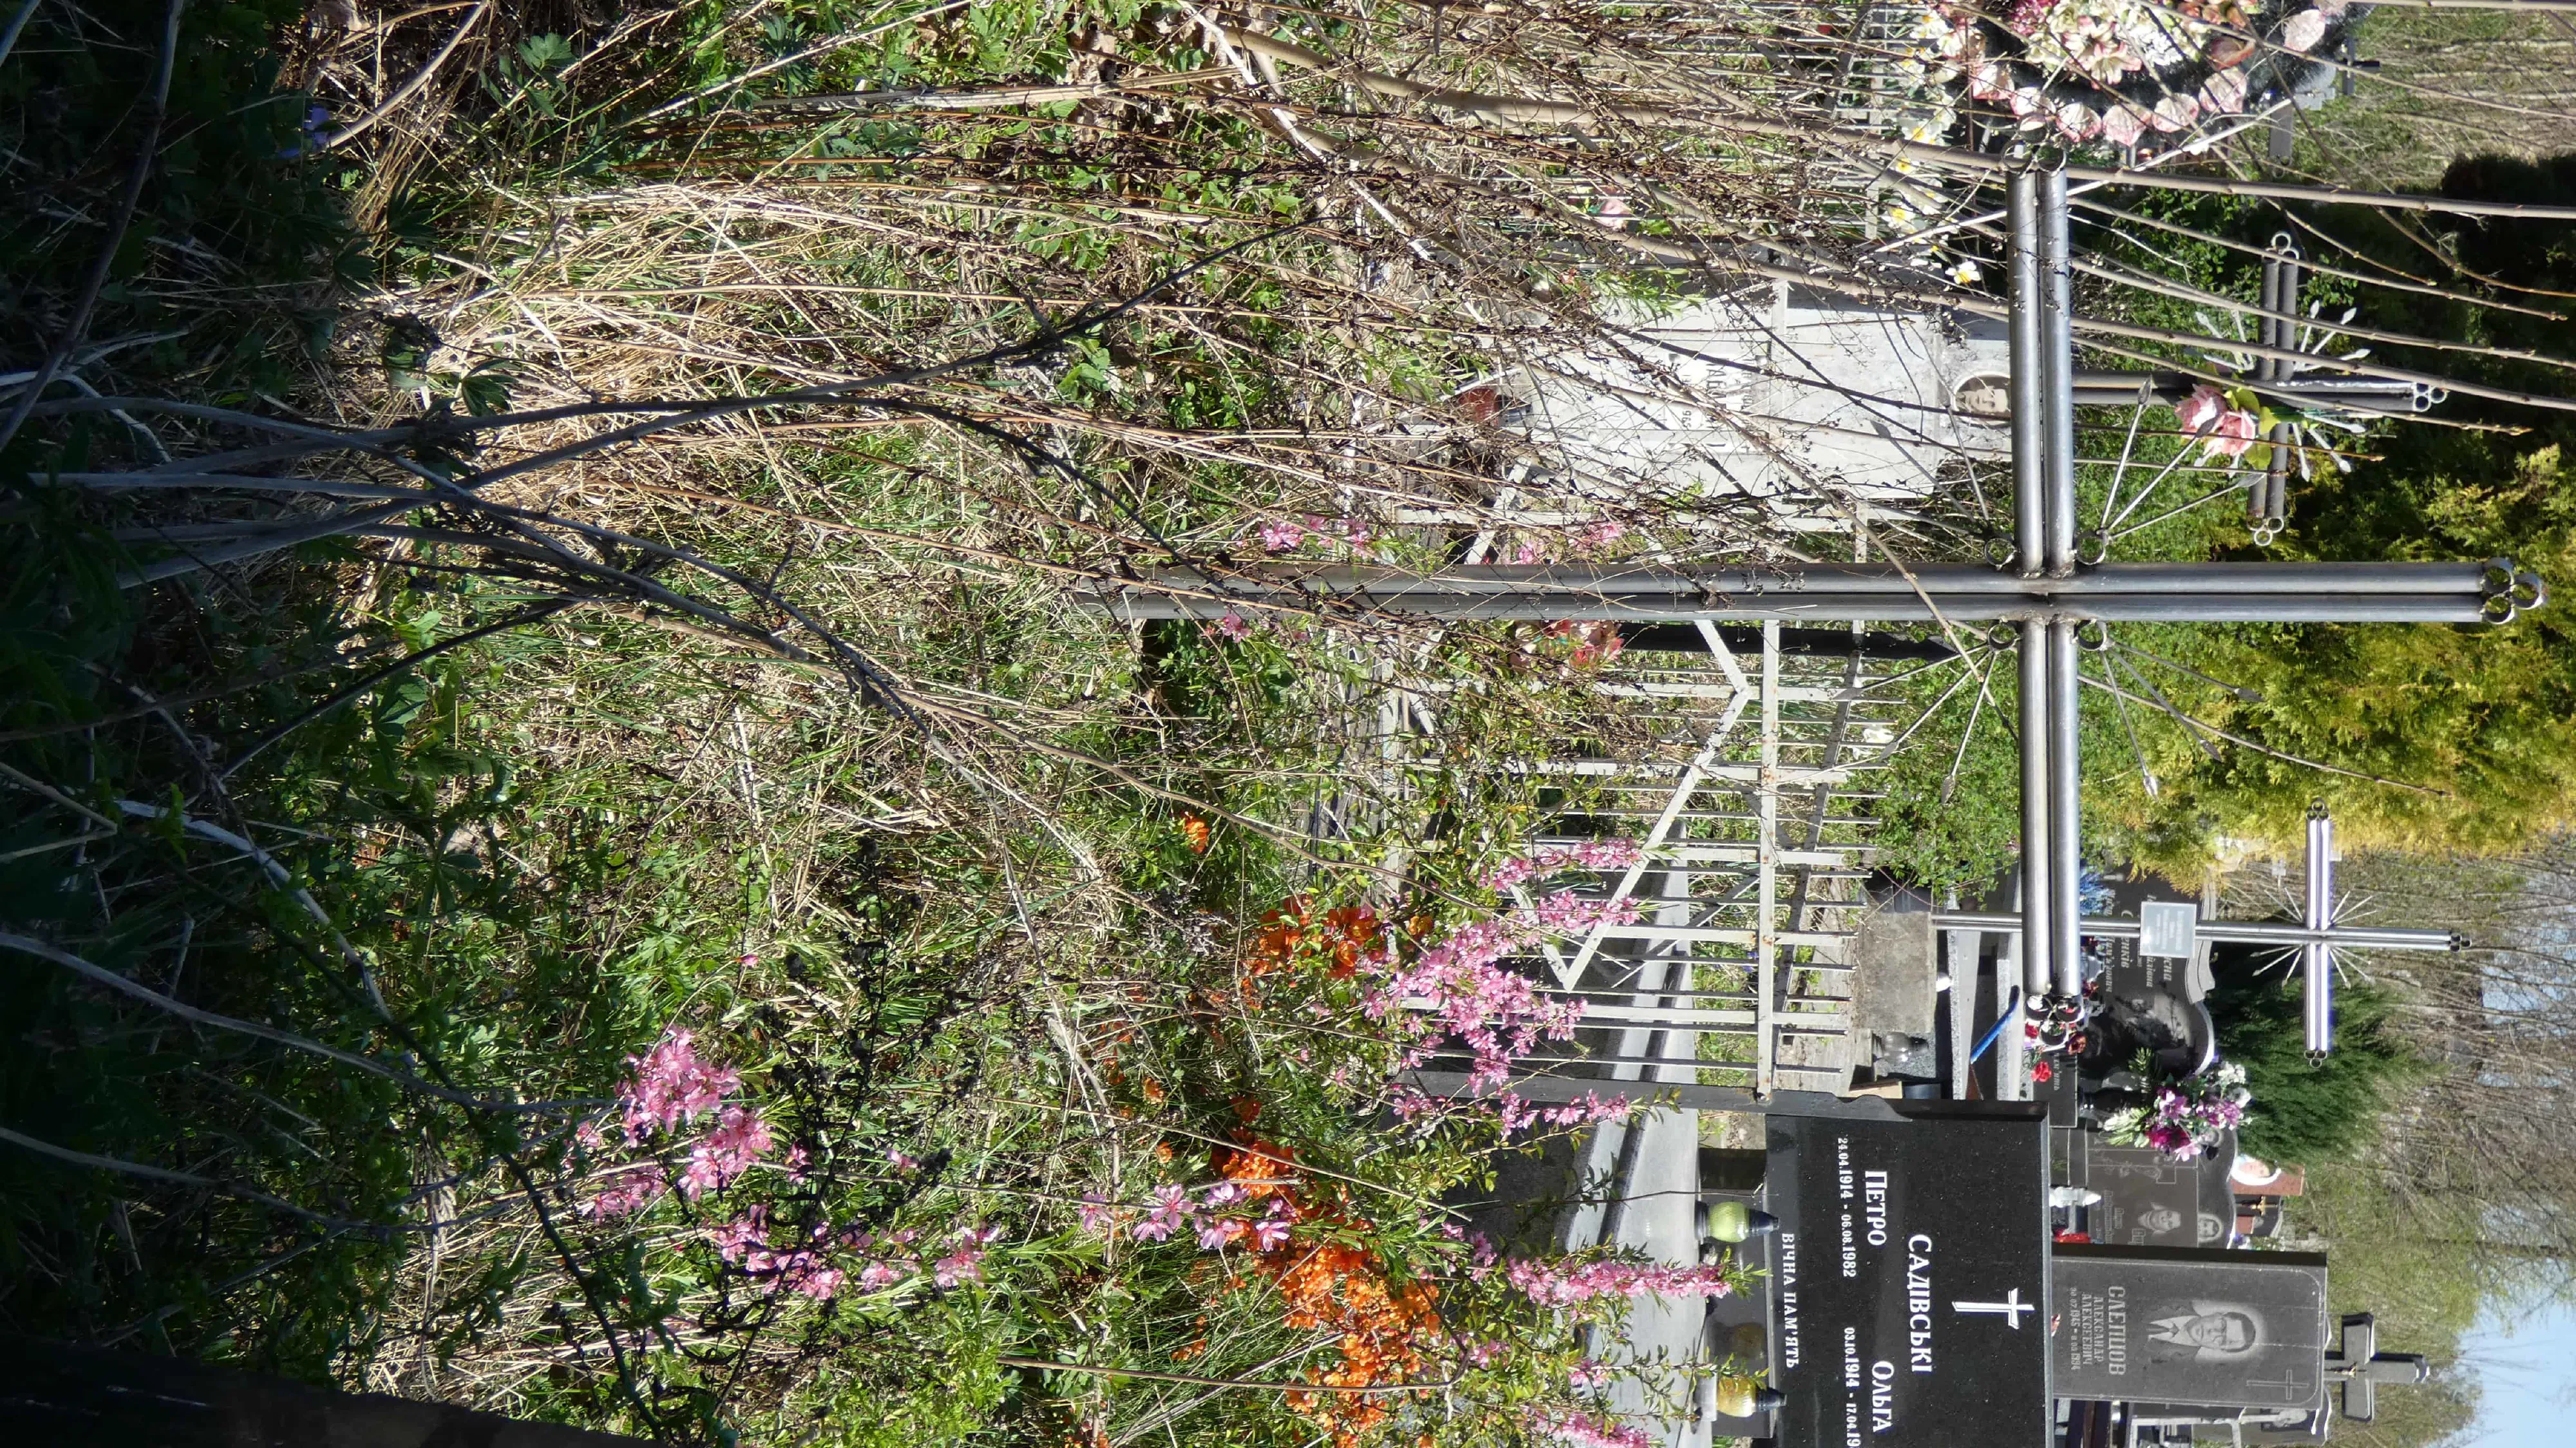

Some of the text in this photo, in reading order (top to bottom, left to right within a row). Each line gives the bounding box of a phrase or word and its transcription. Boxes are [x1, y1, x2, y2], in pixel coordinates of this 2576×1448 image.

[1837, 1138, 1854, 1199] 24.04.1914
[1781, 1233, 1796, 1286] ВІЧНА
[1841, 1214, 1857, 1277] 06.08.1982
[1843, 1327, 1860, 1387] 03.10.1914
[2093, 1297, 2104, 1362] АЛЕКСАНДР
[2107, 1286, 2126, 1375] СЛЕПЦОВ
[1846, 1403, 1861, 1448] 17.04.19
